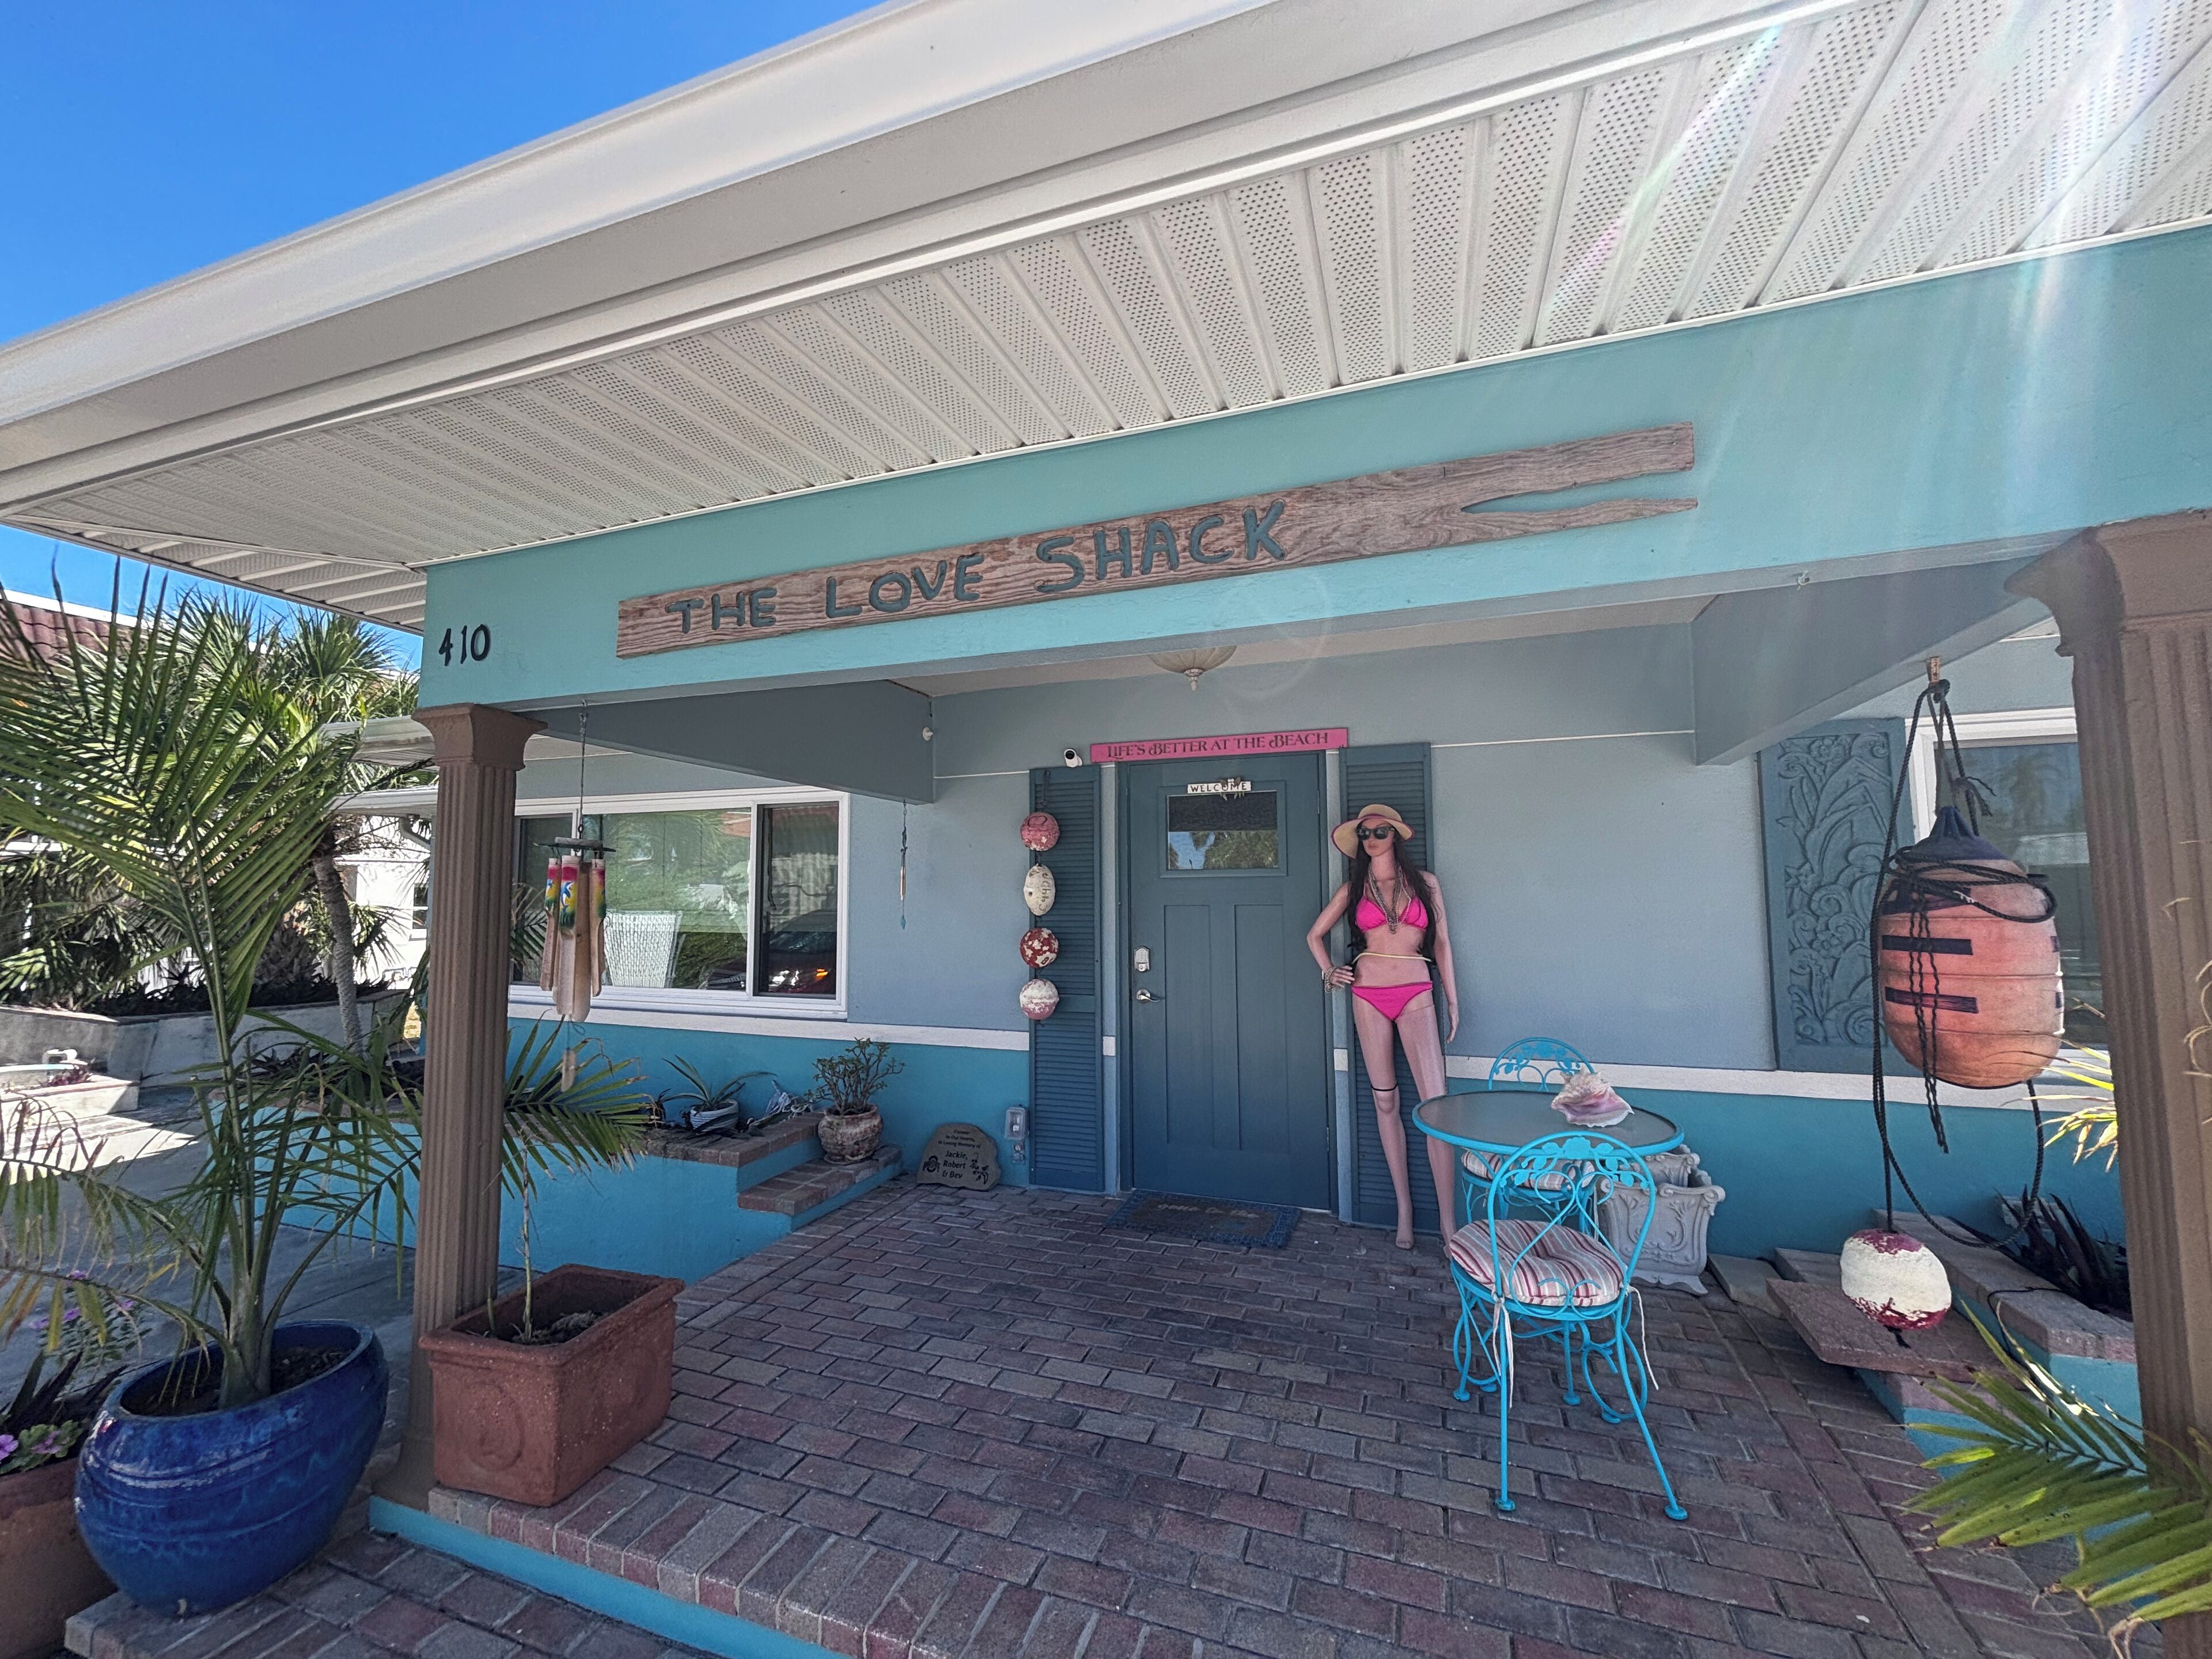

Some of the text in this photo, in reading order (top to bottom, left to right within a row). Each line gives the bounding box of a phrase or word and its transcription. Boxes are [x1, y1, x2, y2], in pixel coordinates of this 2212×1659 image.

[665, 498, 1287, 634] THE LOVE SHACK
[438, 624, 490, 666] 410
[1107, 732, 1328, 759] LIFE'S BETTER AT THE BEACH
[1190, 782, 1247, 793] WELCOME
[945, 1150, 968, 1160] Jackie,
[943, 1160, 966, 1169] Robert
[949, 1171, 963, 1179] Bev
